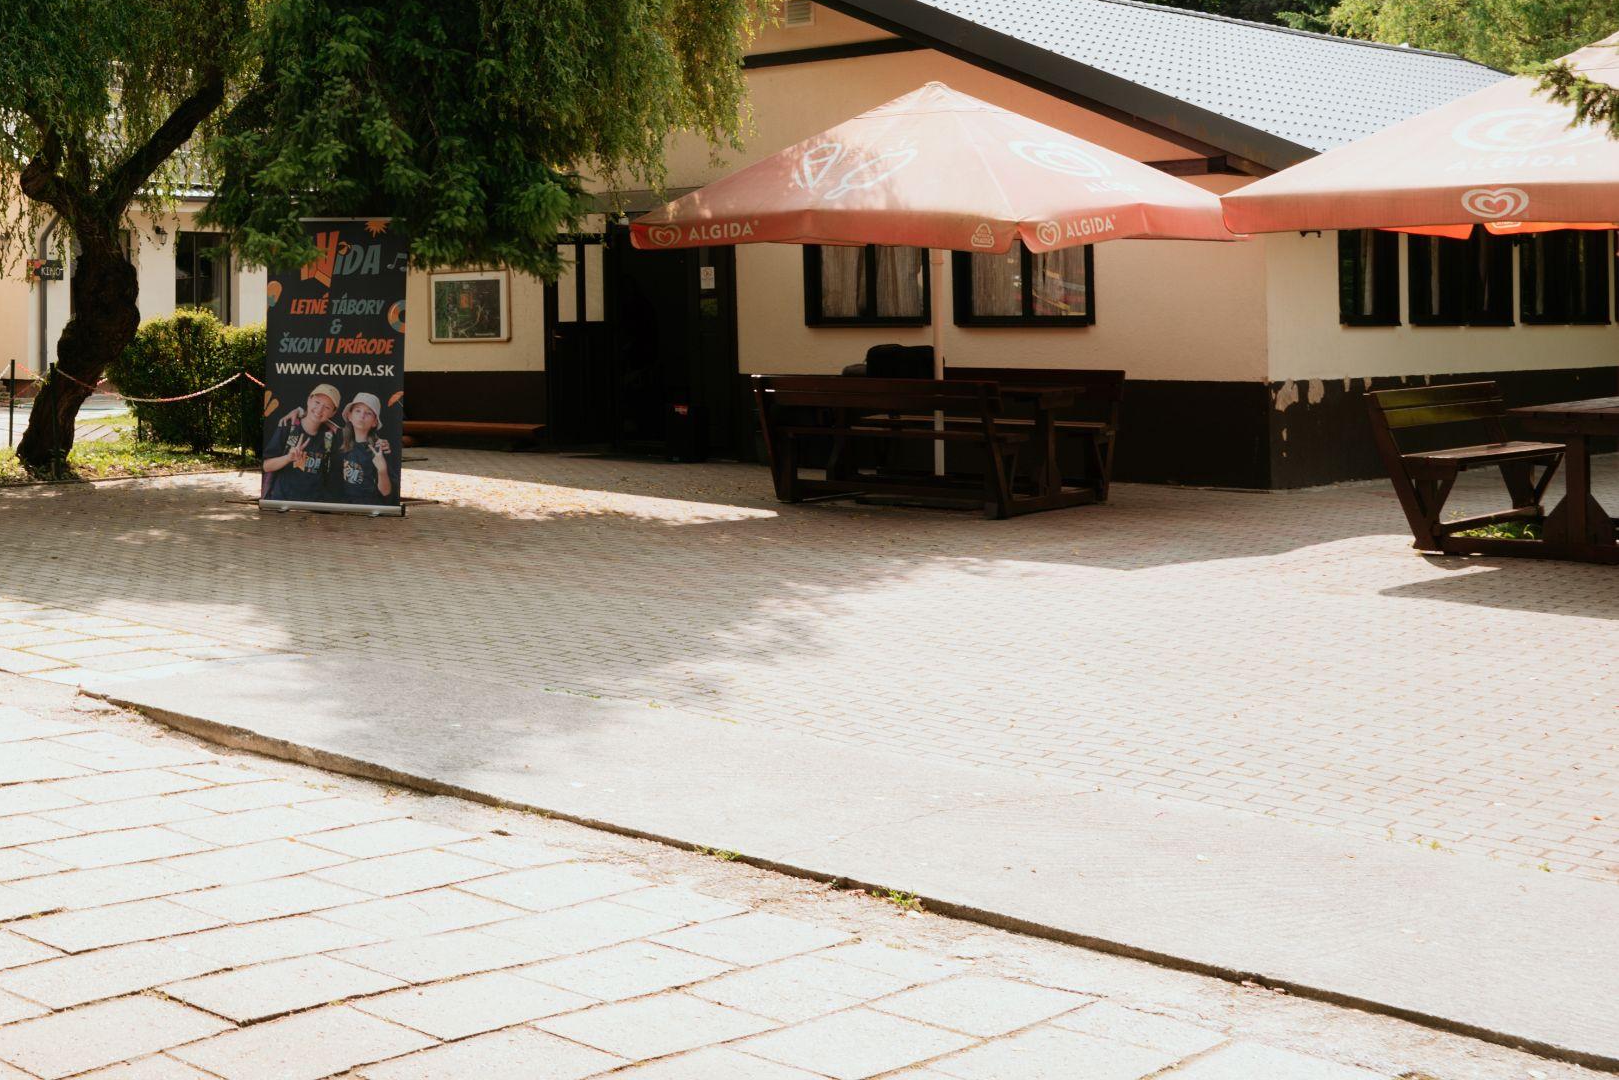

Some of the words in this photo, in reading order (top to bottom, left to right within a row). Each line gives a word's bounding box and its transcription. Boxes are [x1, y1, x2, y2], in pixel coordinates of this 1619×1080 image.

[688, 222, 754, 241] ALGIDA
[1066, 217, 1114, 239] ALGIDA
[290, 292, 330, 315] LETNÉ
[332, 292, 385, 315] TÁBORY
[330, 318, 343, 335] &
[279, 331, 323, 353] ŠKOLY
[324, 338, 336, 354] V
[335, 332, 395, 355] PRÍRODE
[275, 362, 395, 377] WWW.CKVIDA.SK
